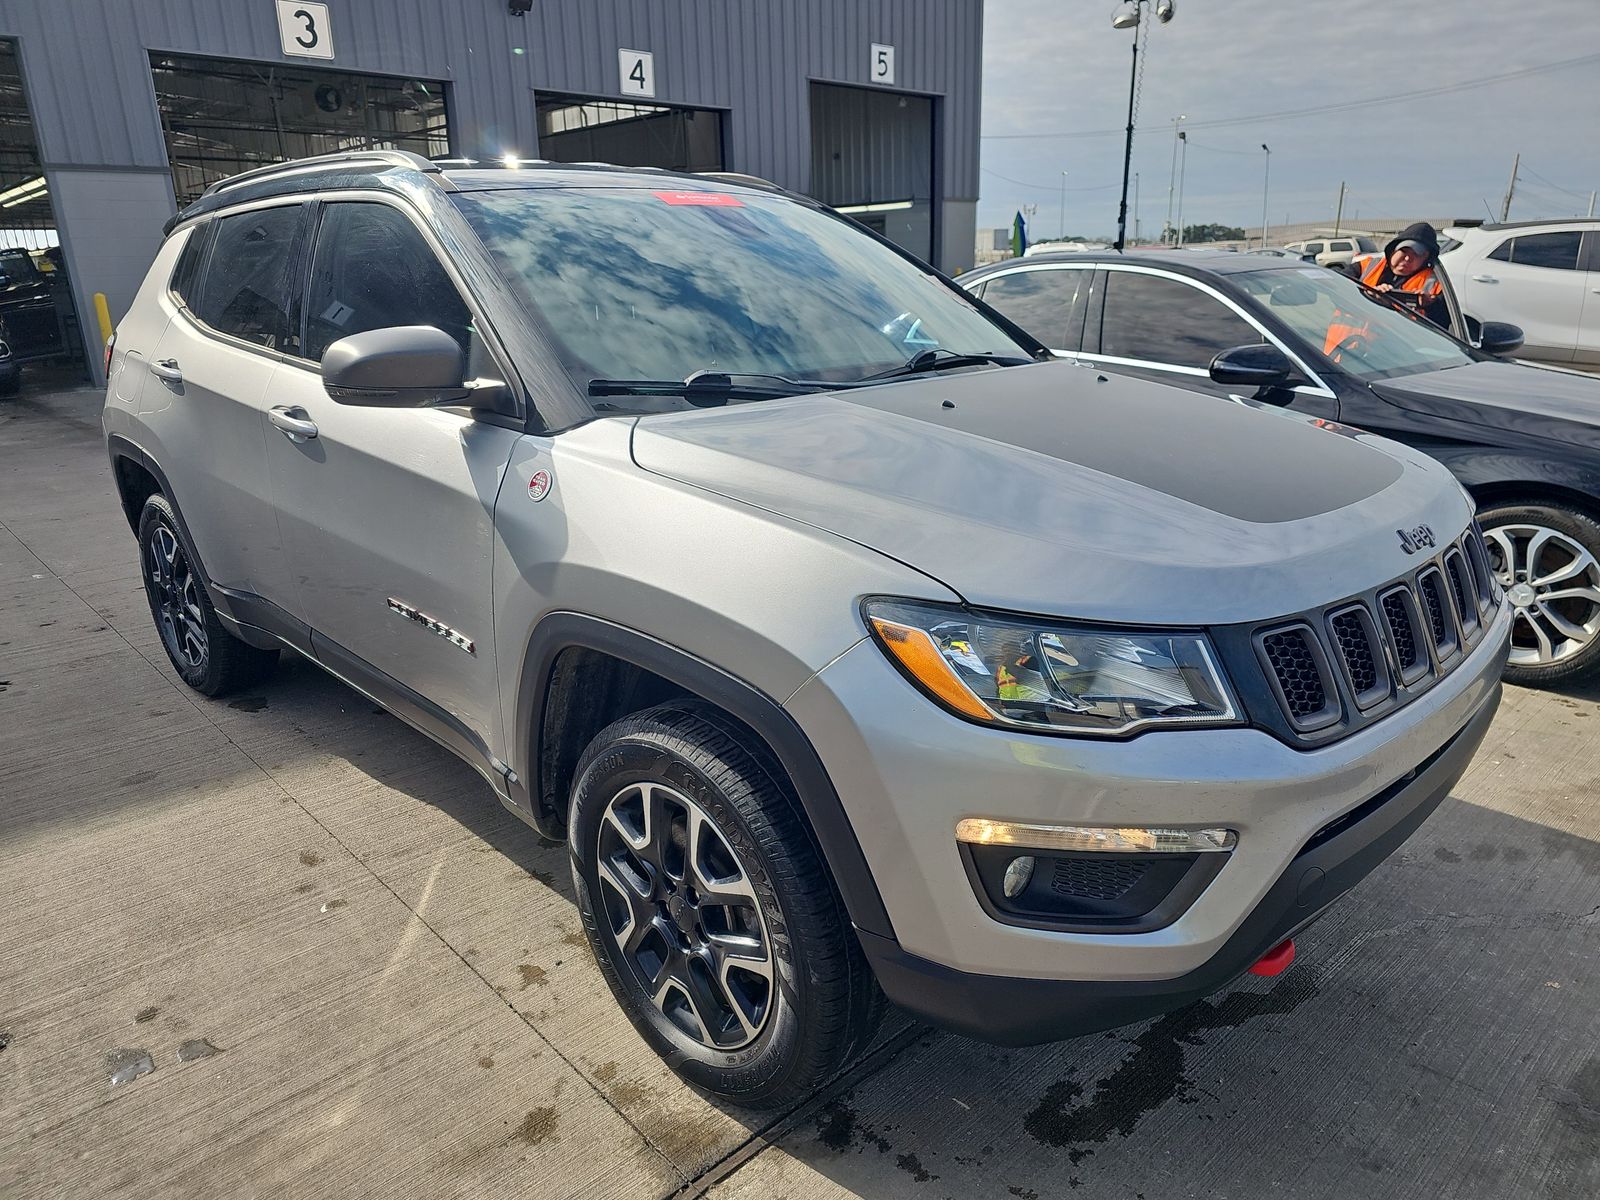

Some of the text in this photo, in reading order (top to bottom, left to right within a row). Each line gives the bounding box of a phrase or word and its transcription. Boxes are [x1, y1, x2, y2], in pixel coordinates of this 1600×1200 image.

[294, 10, 318, 49] 3
[629, 59, 645, 89] 4
[878, 51, 888, 77] 5
[1396, 523, 1436, 555] Jeep
[683, 771, 793, 964] GOODYEAR
